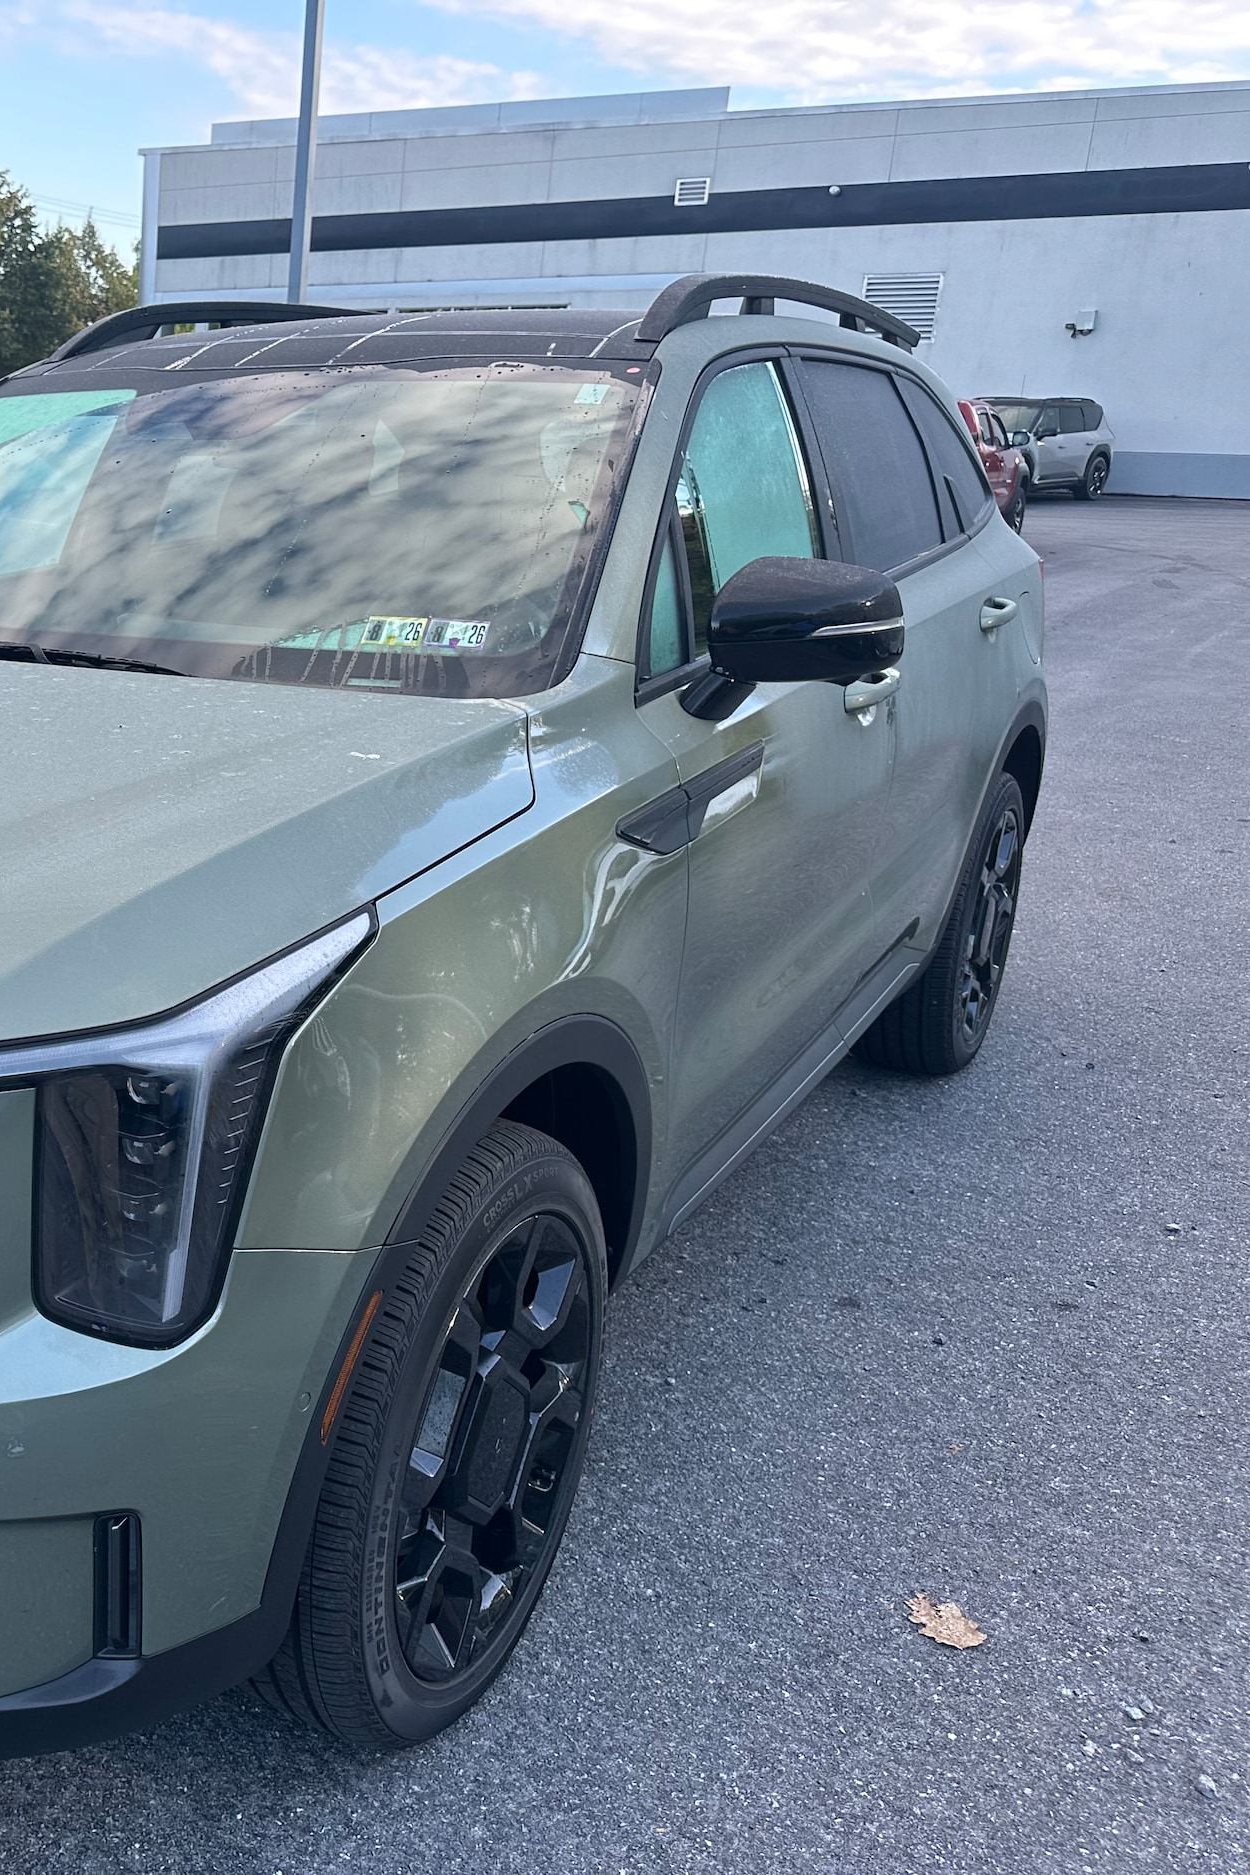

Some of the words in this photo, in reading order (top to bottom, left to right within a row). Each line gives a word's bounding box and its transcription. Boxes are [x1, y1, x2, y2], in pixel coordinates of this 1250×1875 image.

[405, 623, 422, 641] 26
[468, 625, 486, 645] 26
[533, 1167, 559, 1182] SPORT
